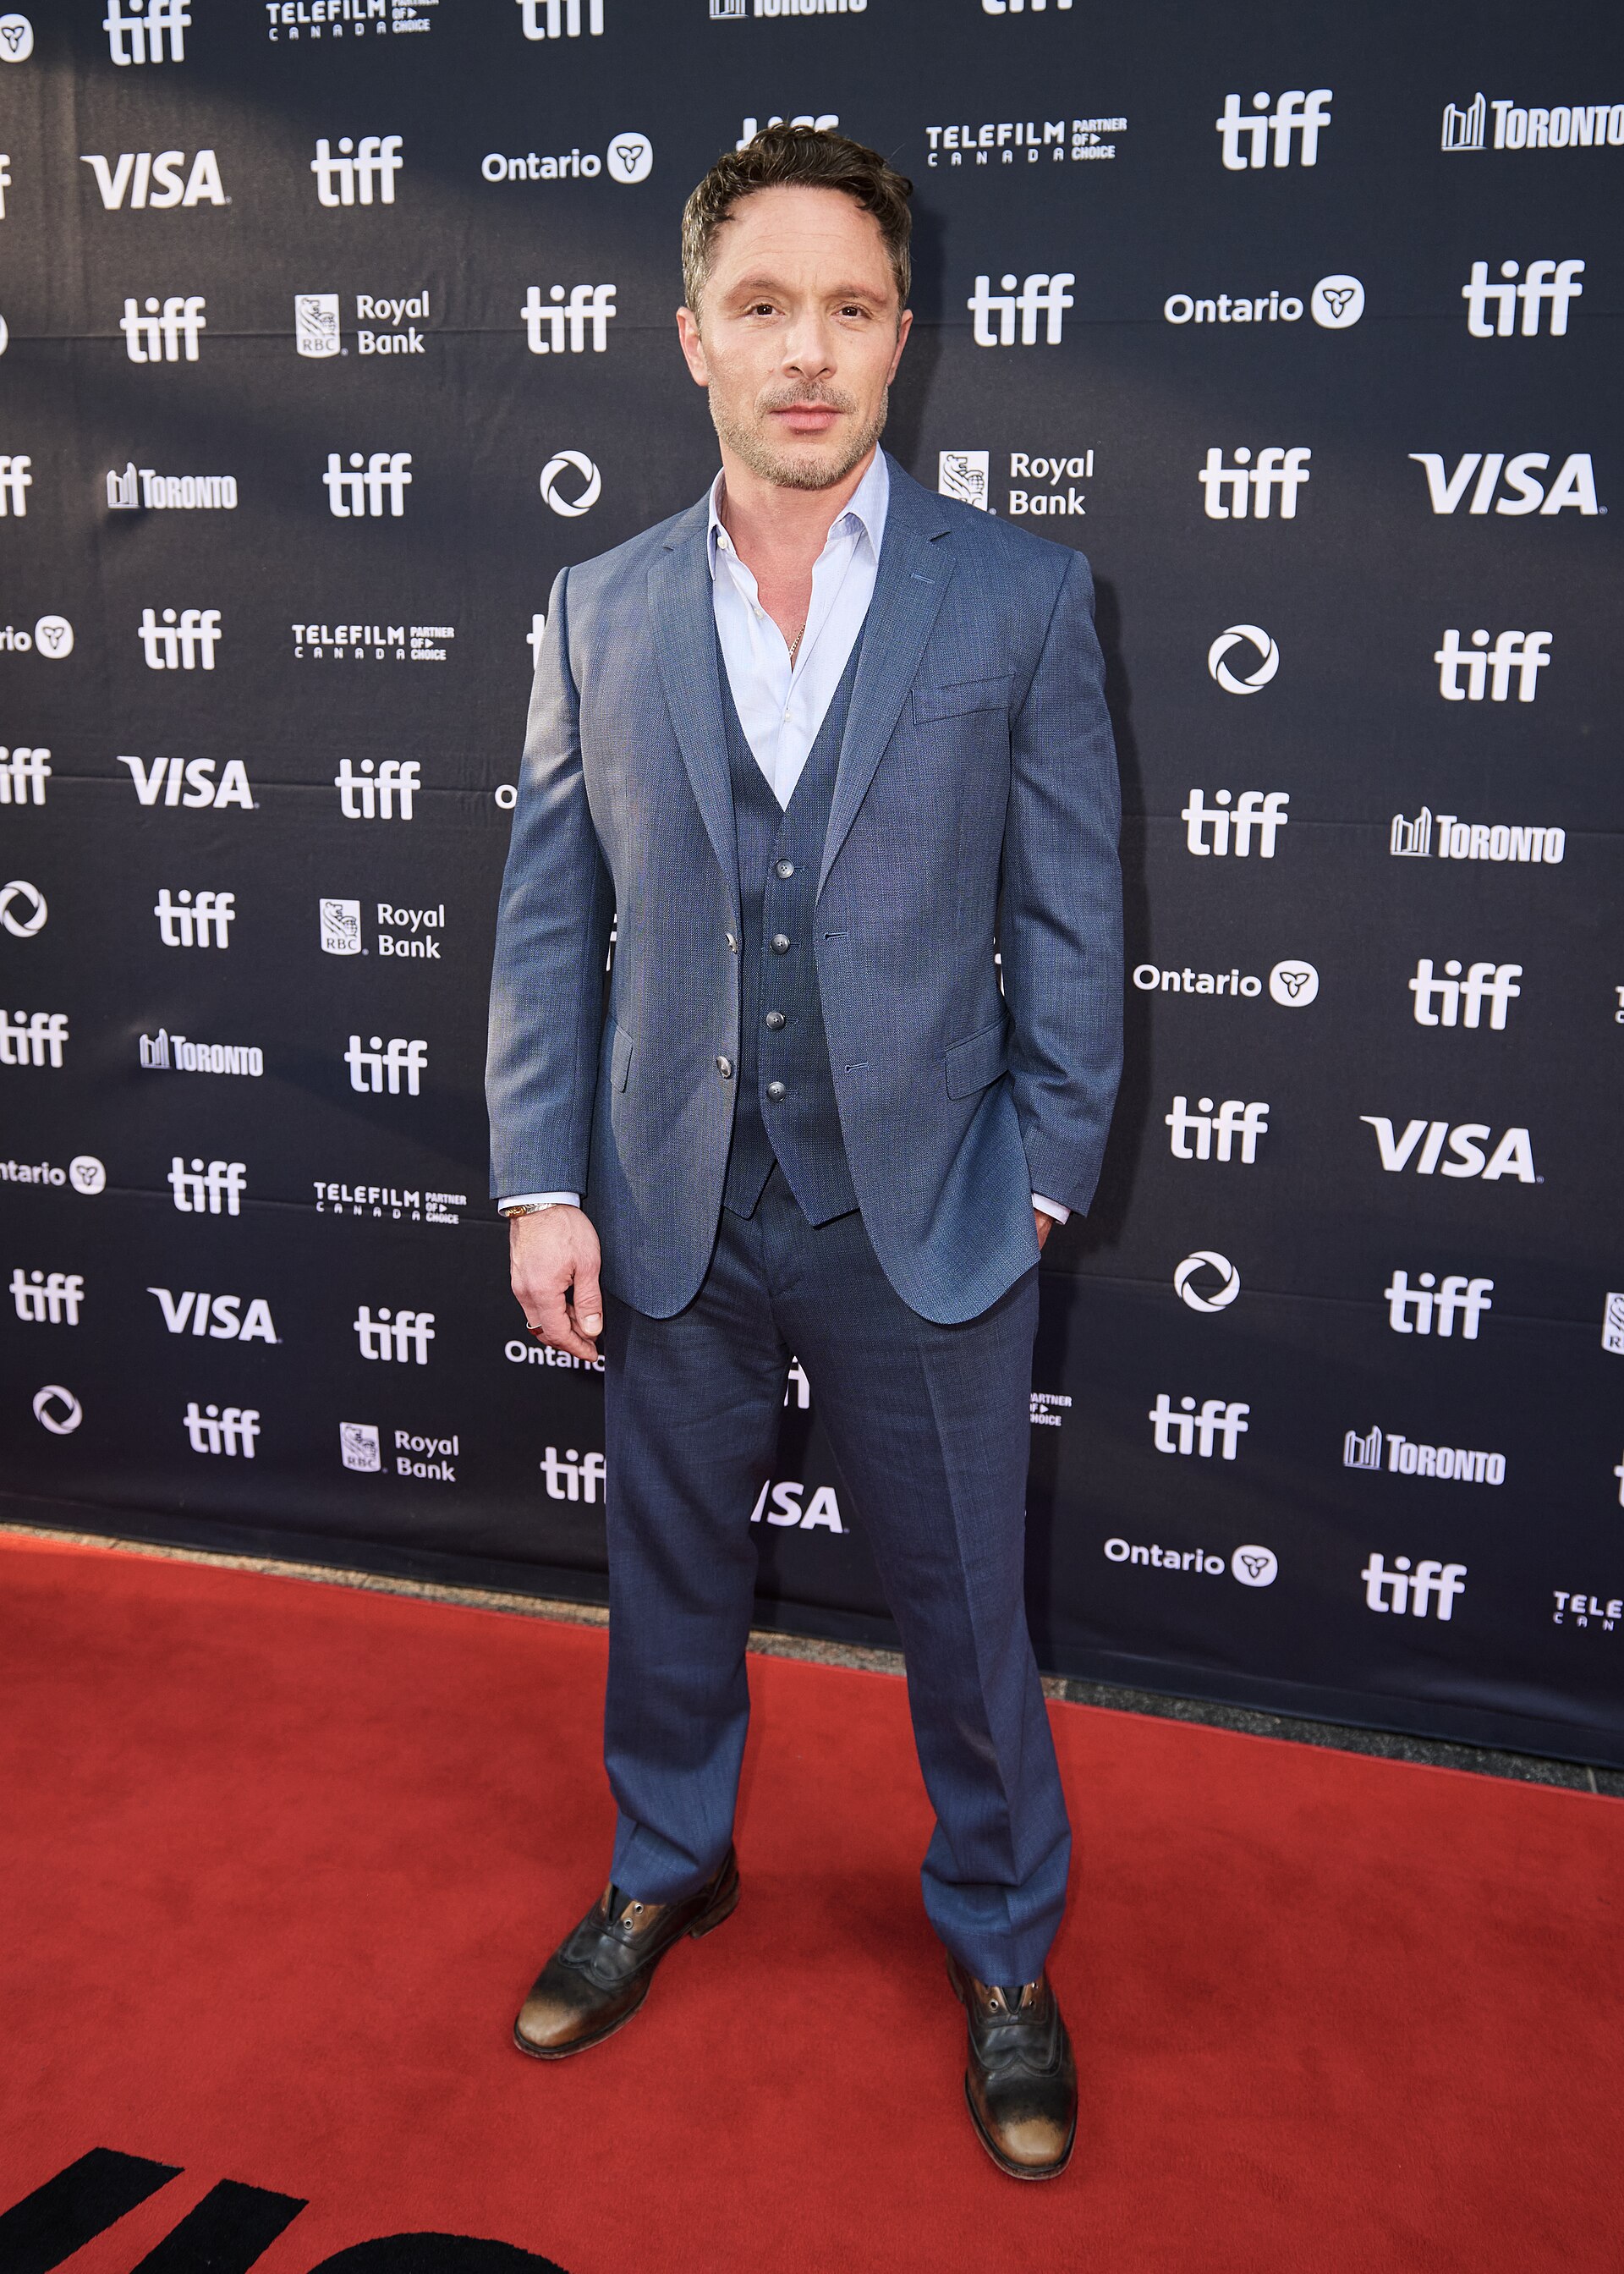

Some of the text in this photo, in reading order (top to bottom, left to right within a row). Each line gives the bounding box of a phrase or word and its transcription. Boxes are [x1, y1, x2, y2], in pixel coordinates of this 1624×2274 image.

[103, 0, 191, 65] tiff
[266, 0, 386, 25] TELEFILM
[269, 21, 386, 41] CANADA
[392, 19, 431, 34] CHOICE
[926, 120, 1065, 150] TELEFILM
[1072, 118, 1127, 133] PARTNER
[1072, 133, 1089, 146] OF
[1216, 90, 1332, 169] tiff
[1491, 101, 1624, 149] TORONTO
[310, 136, 403, 206] tiff
[482, 149, 601, 181] Ontario
[928, 147, 1064, 168] CANADA
[1072, 145, 1116, 161] CHOICE
[80, 151, 225, 209] VISA
[357, 291, 429, 325] Royal
[521, 284, 616, 354] tiff
[968, 273, 1074, 346] tiff
[1165, 291, 1303, 323] Ontario
[1462, 260, 1584, 337] tiff
[120, 297, 206, 362] tiff
[303, 338, 335, 351] RBC
[358, 327, 425, 354] Bank
[323, 453, 412, 517] tiff
[1011, 450, 1093, 485] Royal
[1199, 448, 1311, 519] tiff
[1408, 453, 1598, 515] VISA
[139, 470, 237, 508] TORONTO
[1010, 488, 1085, 514] Bank
[138, 609, 222, 669] tiff
[292, 624, 404, 645] TELEFILM
[410, 626, 454, 638] PARTNER
[410, 638, 424, 649] OF
[294, 646, 405, 660] CANADA
[410, 649, 447, 661] CHOICE
[1435, 629, 1552, 701] tiff
[118, 756, 254, 809] VISA
[335, 759, 420, 820] tiff
[1182, 789, 1289, 858] tiff
[1436, 816, 1565, 863] TORONTO
[155, 889, 235, 948] tiff
[378, 904, 444, 932] Royal
[326, 939, 357, 950] RBC
[379, 935, 441, 958] Bank
[1133, 964, 1261, 997] Ontario
[1409, 959, 1522, 1030] tiff
[0, 1010, 69, 1068] tiff
[171, 1035, 263, 1076] TORONTO
[344, 1035, 427, 1096] tiff
[1166, 1096, 1269, 1163] tiff
[1360, 1116, 1535, 1183] VISA
[167, 1157, 246, 1216] tiff
[313, 1182, 420, 1208] TELEFILM
[425, 1192, 467, 1206] PARTNER
[425, 1202, 438, 1212] OF
[316, 1201, 420, 1221] CANADA
[425, 1211, 459, 1224] CHOICE
[9, 1269, 84, 1325] tiff
[147, 1288, 277, 1343] VISA
[1385, 1271, 1494, 1339] tiff
[354, 1306, 435, 1365] tiff
[1030, 1392, 1073, 1407] ARTNER
[184, 1403, 260, 1458] tiff
[395, 1431, 458, 1458] Royal
[1149, 1394, 1249, 1459] tiff
[397, 1457, 455, 1481] Bank
[540, 1447, 606, 1503] tif
[1386, 1435, 1506, 1485] TORONTO
[1105, 1539, 1225, 1574] Ontario
[1362, 1553, 1467, 1620] tiff
